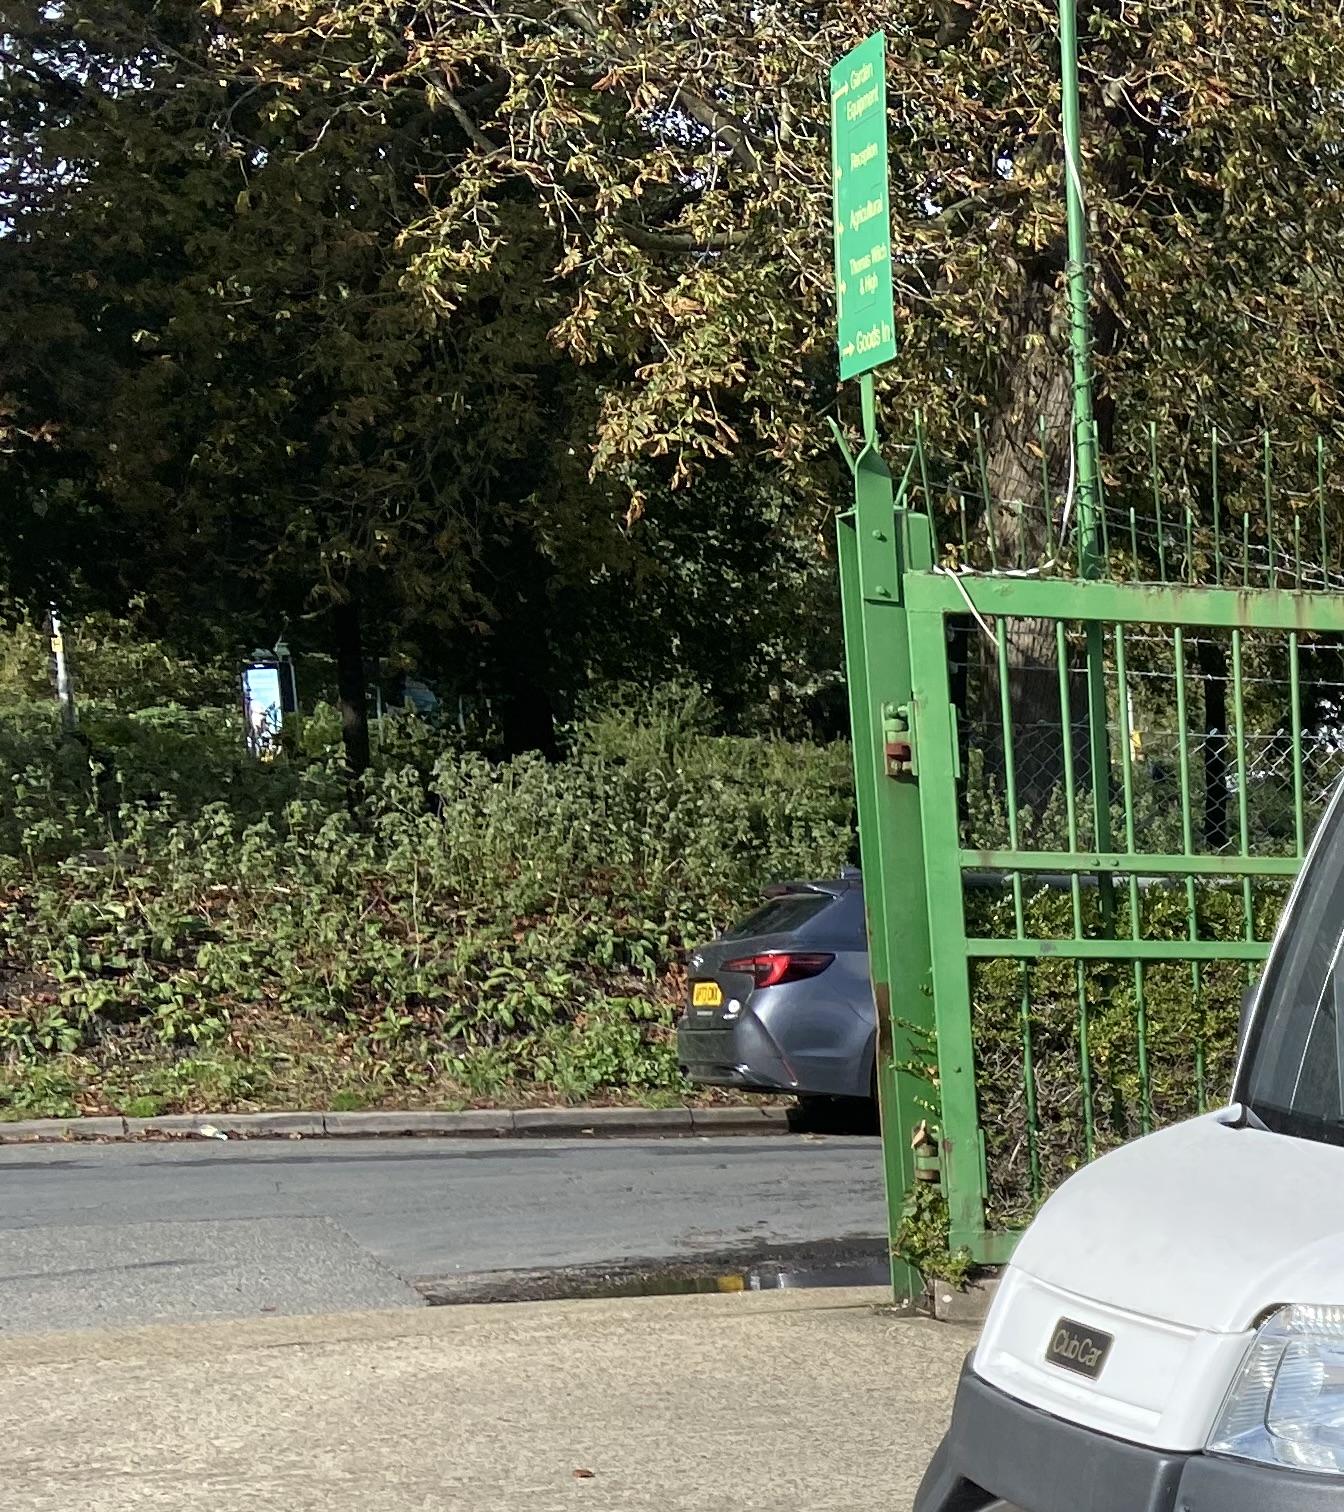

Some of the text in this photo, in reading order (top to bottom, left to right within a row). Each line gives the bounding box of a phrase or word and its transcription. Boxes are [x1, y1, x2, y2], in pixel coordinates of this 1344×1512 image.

[851, 62, 873, 90] Garden
[847, 83, 879, 121] Equipment
[851, 142, 878, 171] Reception
[850, 192, 883, 231] Agricultural
[856, 320, 891, 354] Goods In
[1053, 1329, 1103, 1367] Club Car
